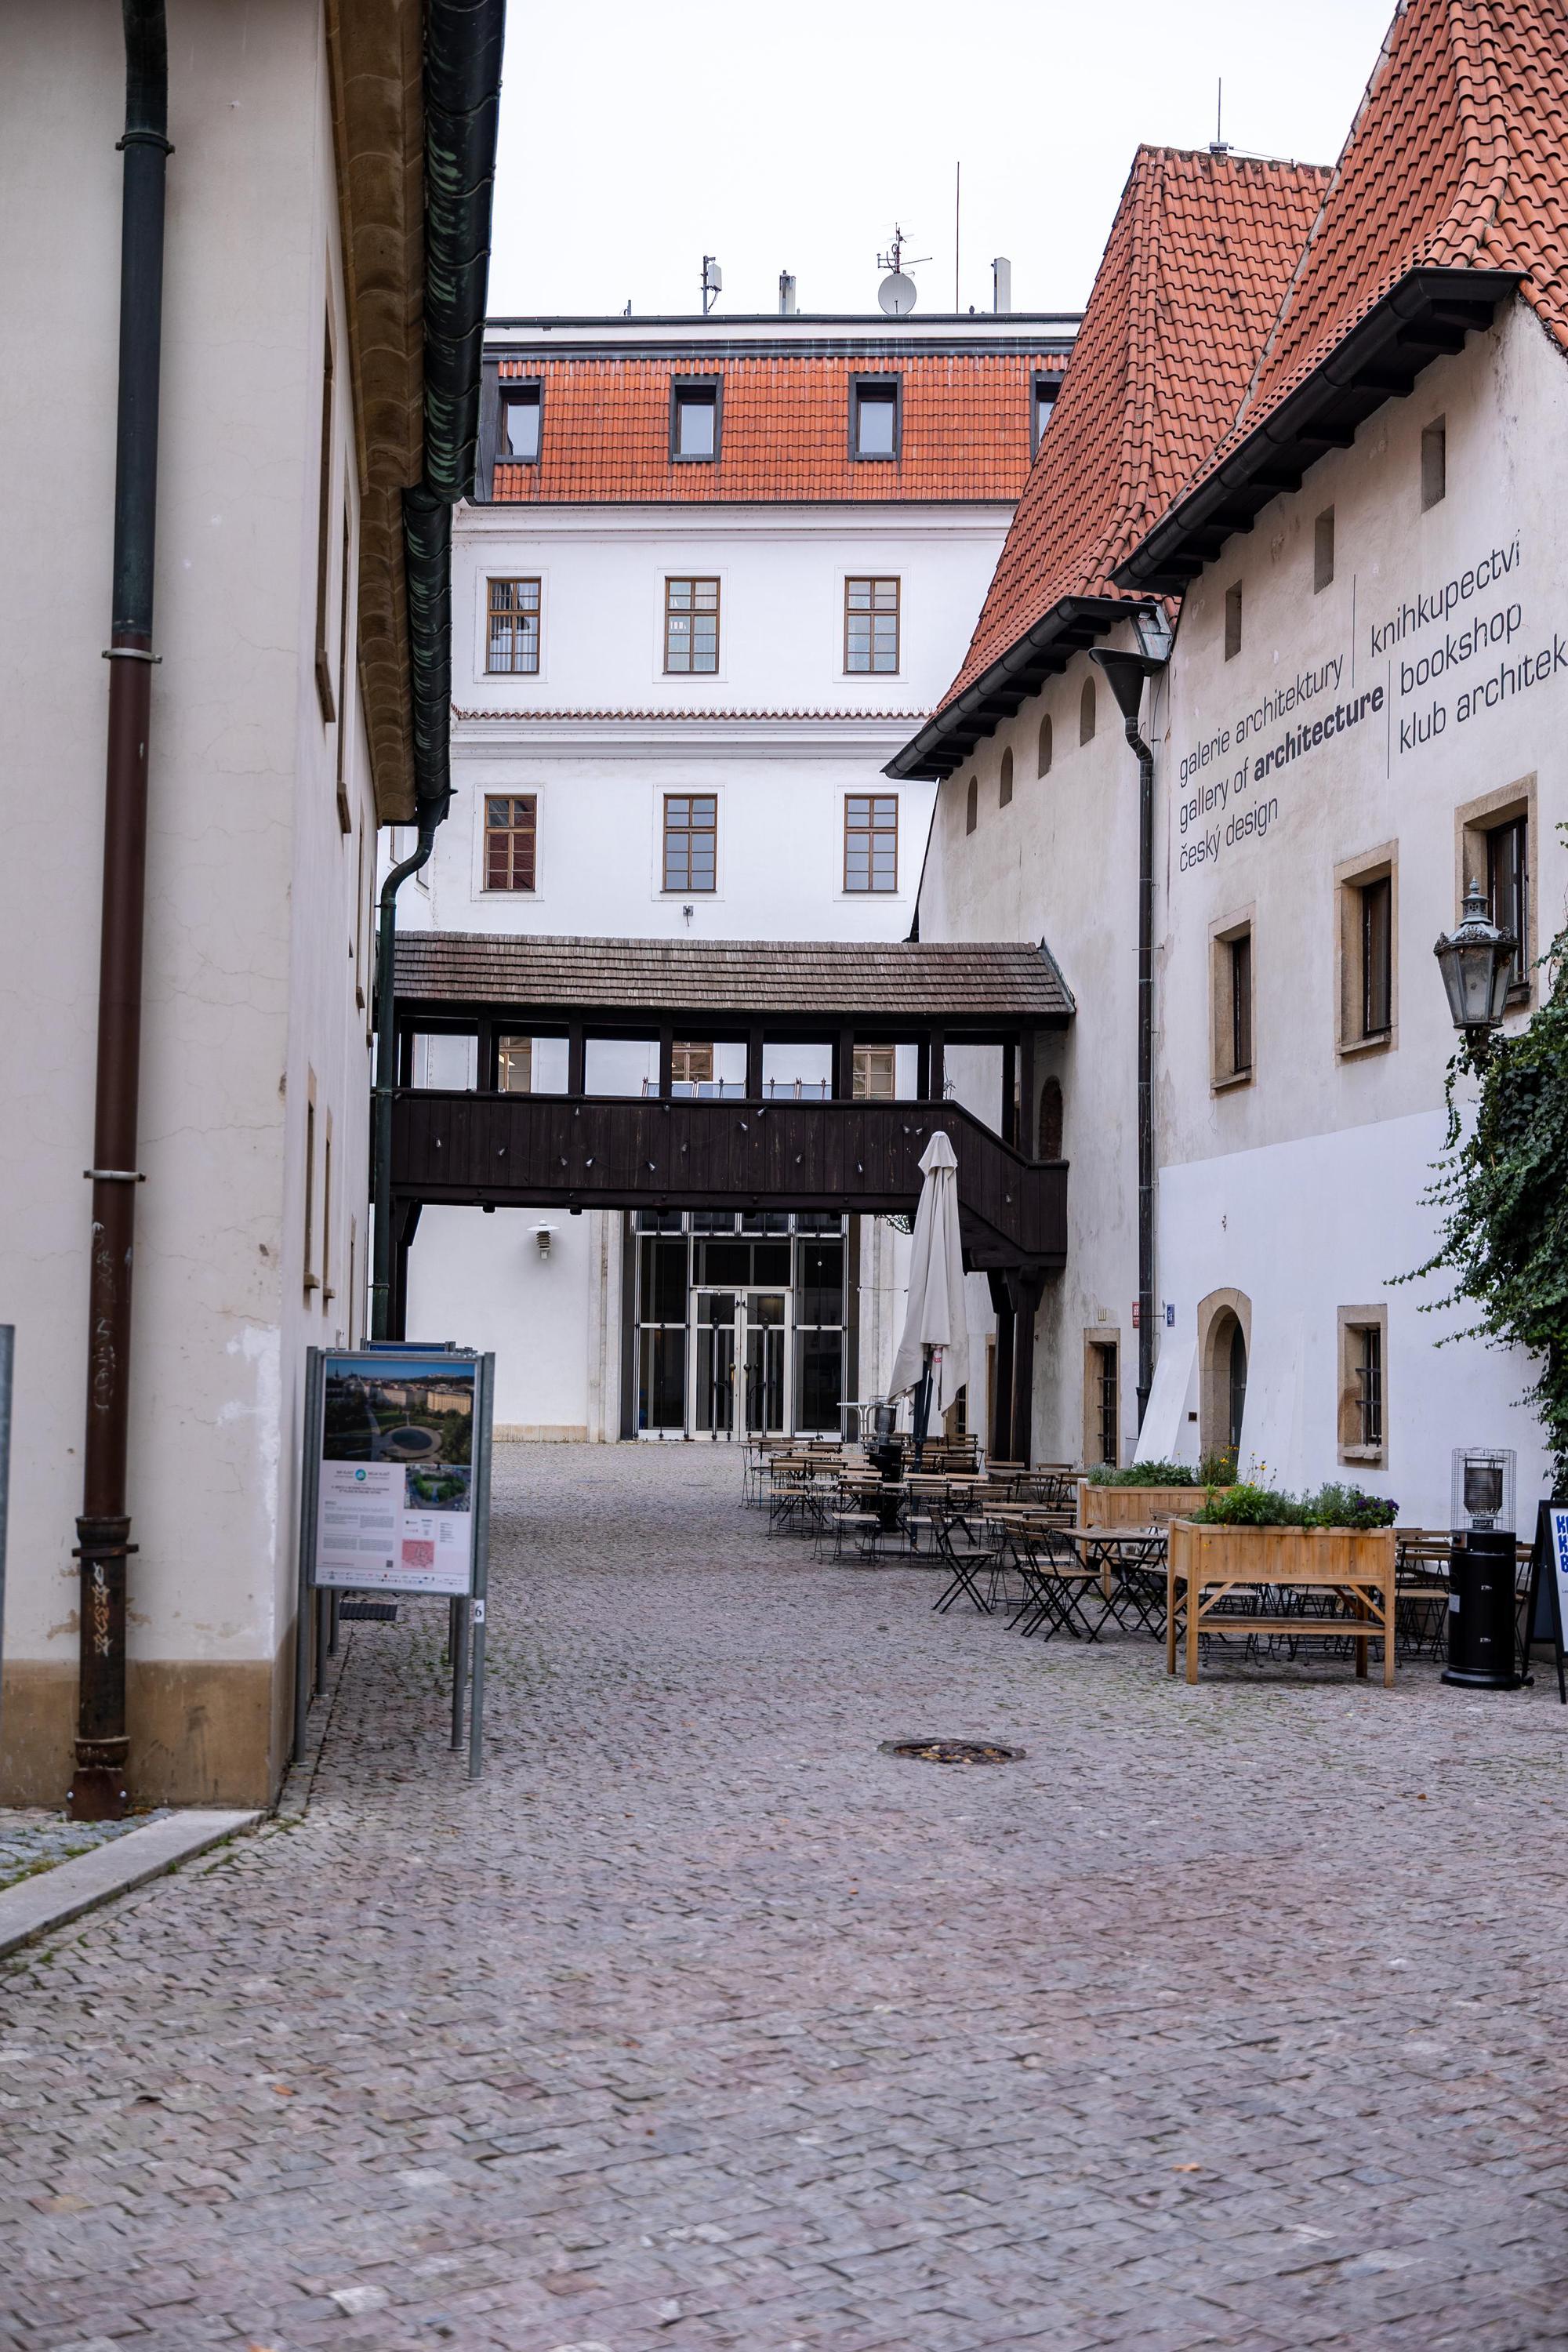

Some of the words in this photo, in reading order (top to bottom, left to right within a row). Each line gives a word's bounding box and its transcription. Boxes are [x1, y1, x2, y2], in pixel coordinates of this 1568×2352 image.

[1371, 528, 1520, 658] knihkupectví
[1401, 602, 1522, 696] bookshop
[1179, 728, 1230, 788] galerie
[1236, 654, 1343, 744] architektury
[1179, 779, 1229, 833] gallery
[1234, 757, 1249, 793] of
[1254, 685, 1384, 782] architecture
[1400, 700, 1446, 753] klub
[1179, 823, 1221, 872] český
[1226, 797, 1278, 846] design
[475, 1605, 482, 1617] 6
